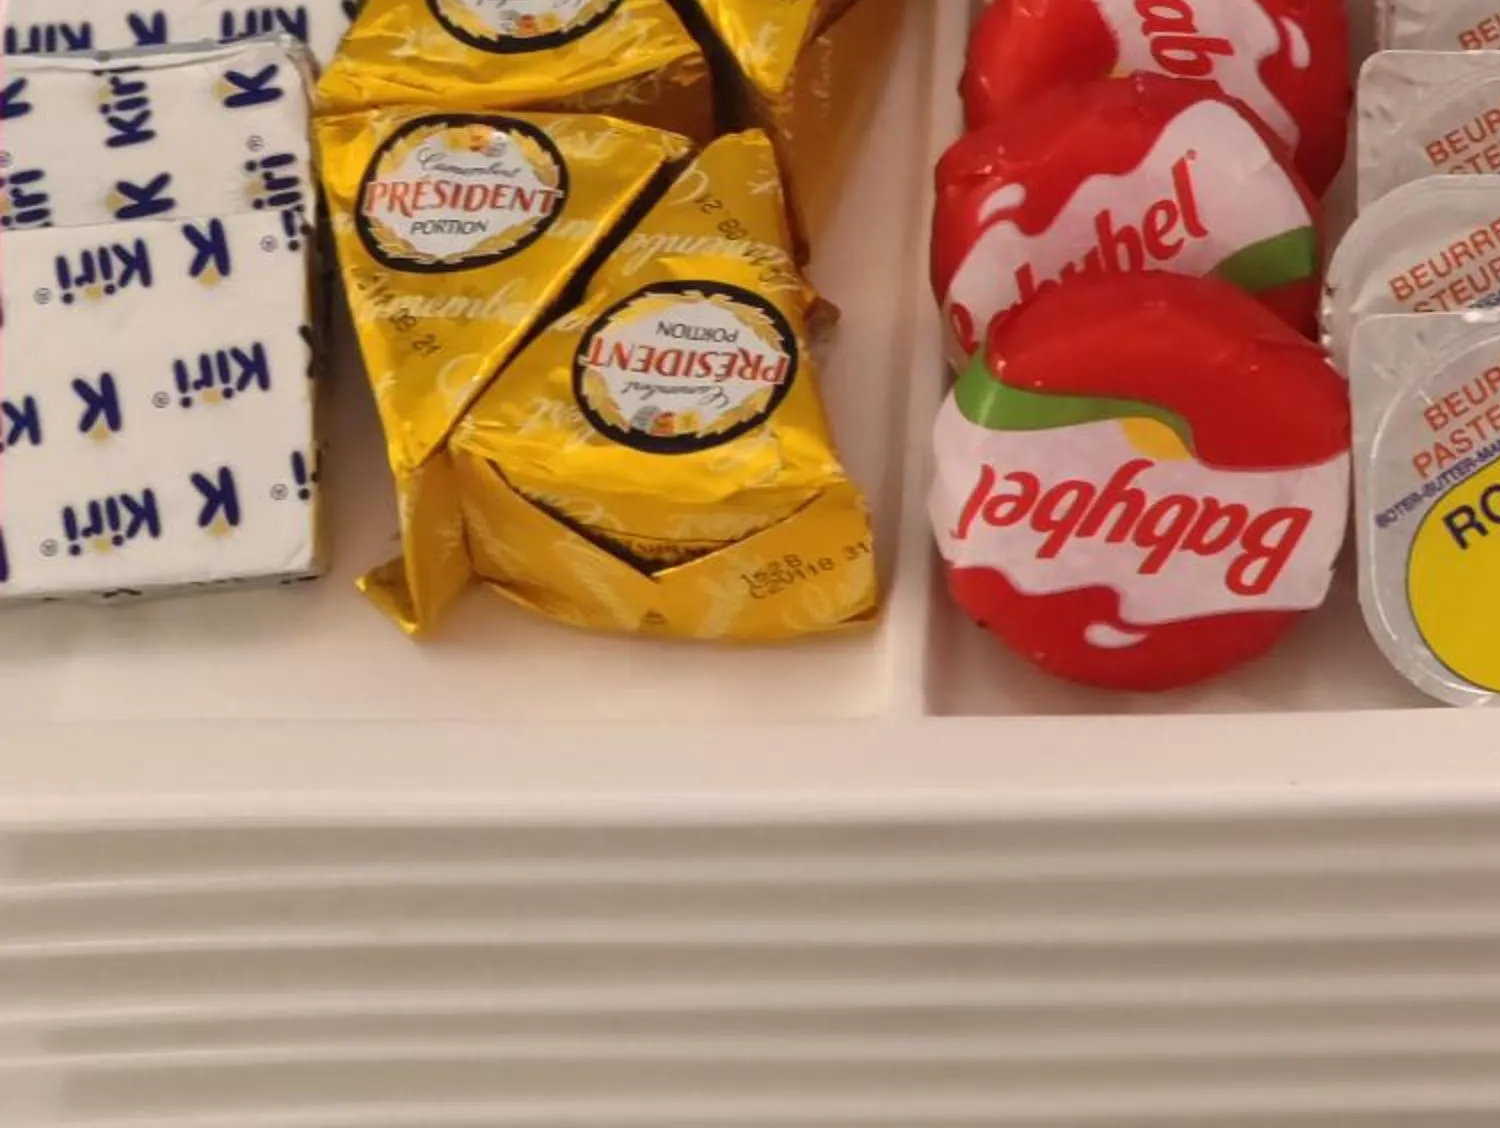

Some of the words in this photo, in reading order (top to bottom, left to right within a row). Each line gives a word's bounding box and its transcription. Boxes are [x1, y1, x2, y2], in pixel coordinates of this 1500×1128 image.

[224, 64, 284, 108] K
[115, 172, 176, 219] K
[182, 218, 230, 278] K
[410, 218, 490, 236] PORTION
[55, 238, 152, 304] Kiri
[655, 319, 740, 344] PORTION
[72, 372, 122, 433] K
[173, 342, 270, 408] Kiri
[61, 487, 161, 556] Kiri
[191, 466, 240, 527] K
[950, 458, 1314, 599] Babybel
